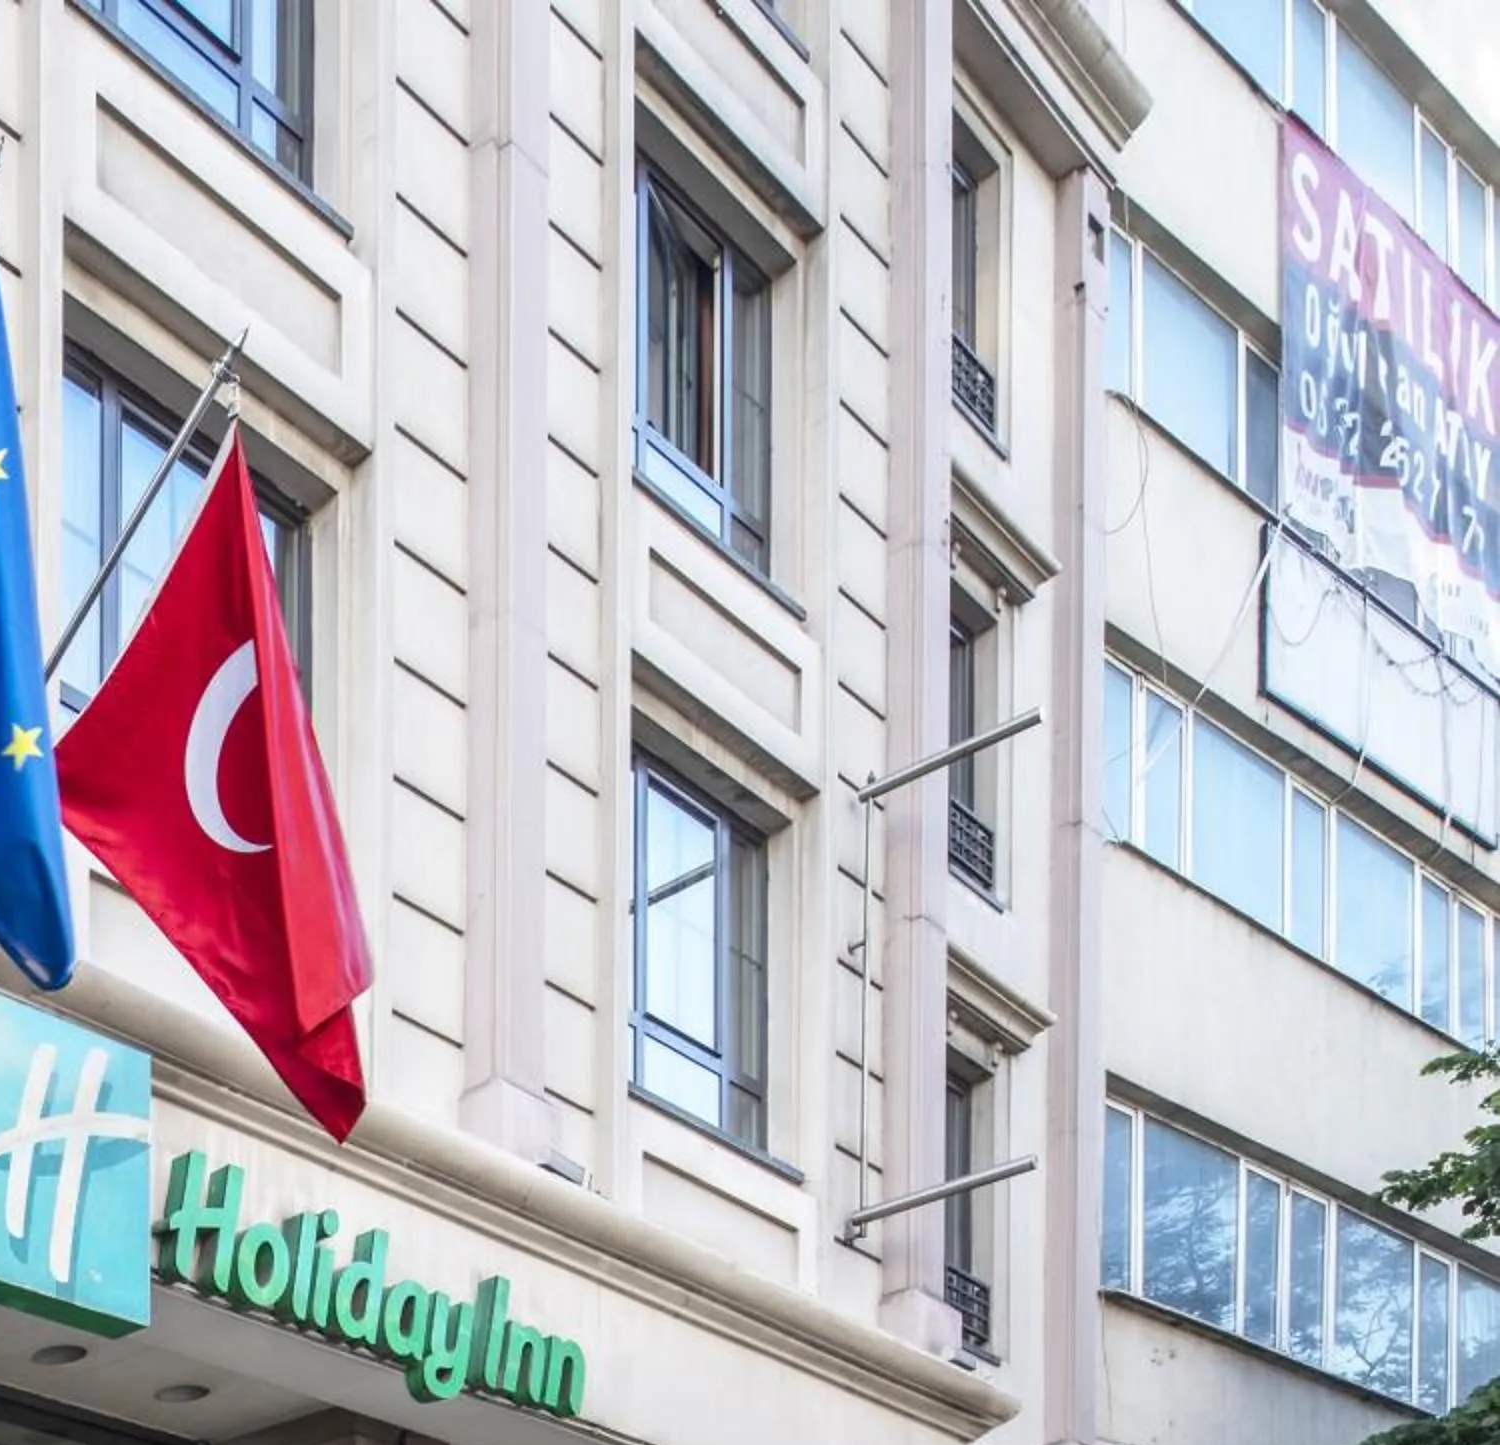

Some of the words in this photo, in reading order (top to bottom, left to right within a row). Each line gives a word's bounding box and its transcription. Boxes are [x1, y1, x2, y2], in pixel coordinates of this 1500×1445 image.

[1292, 153, 1498, 437] SATILIK
[160, 1150, 473, 1402] Holiday
[470, 1275, 586, 1417] Inn
